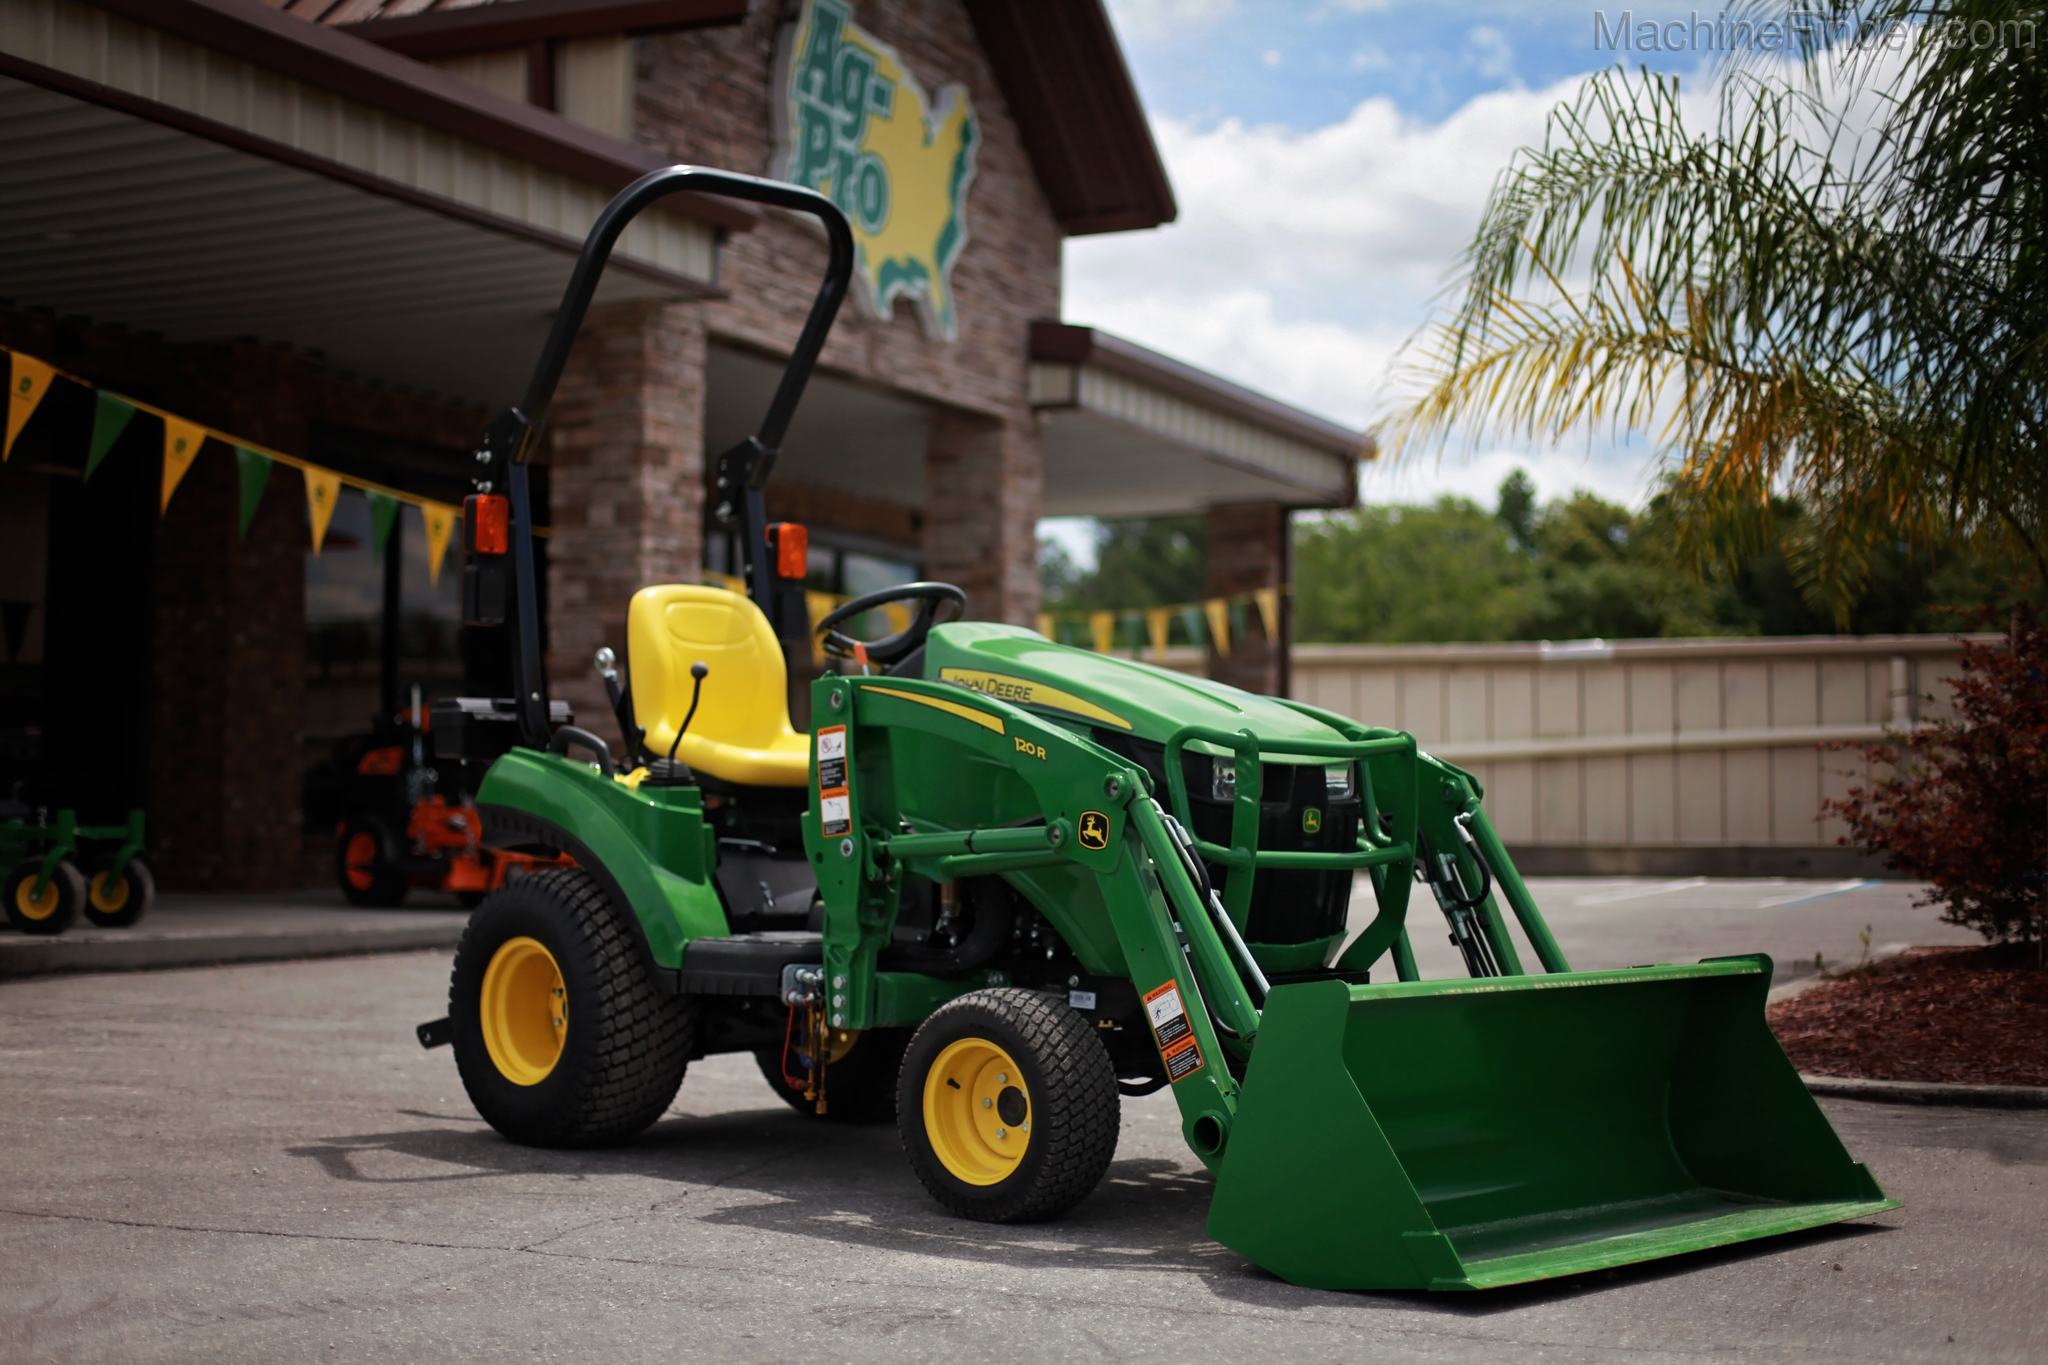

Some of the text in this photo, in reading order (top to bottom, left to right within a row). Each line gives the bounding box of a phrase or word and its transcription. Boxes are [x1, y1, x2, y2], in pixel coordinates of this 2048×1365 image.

[797, 102, 886, 229] Pro
[987, 678, 1033, 700] DEERE
[1151, 983, 1172, 998] WARNING
[1171, 1039, 1193, 1055] WARNING
